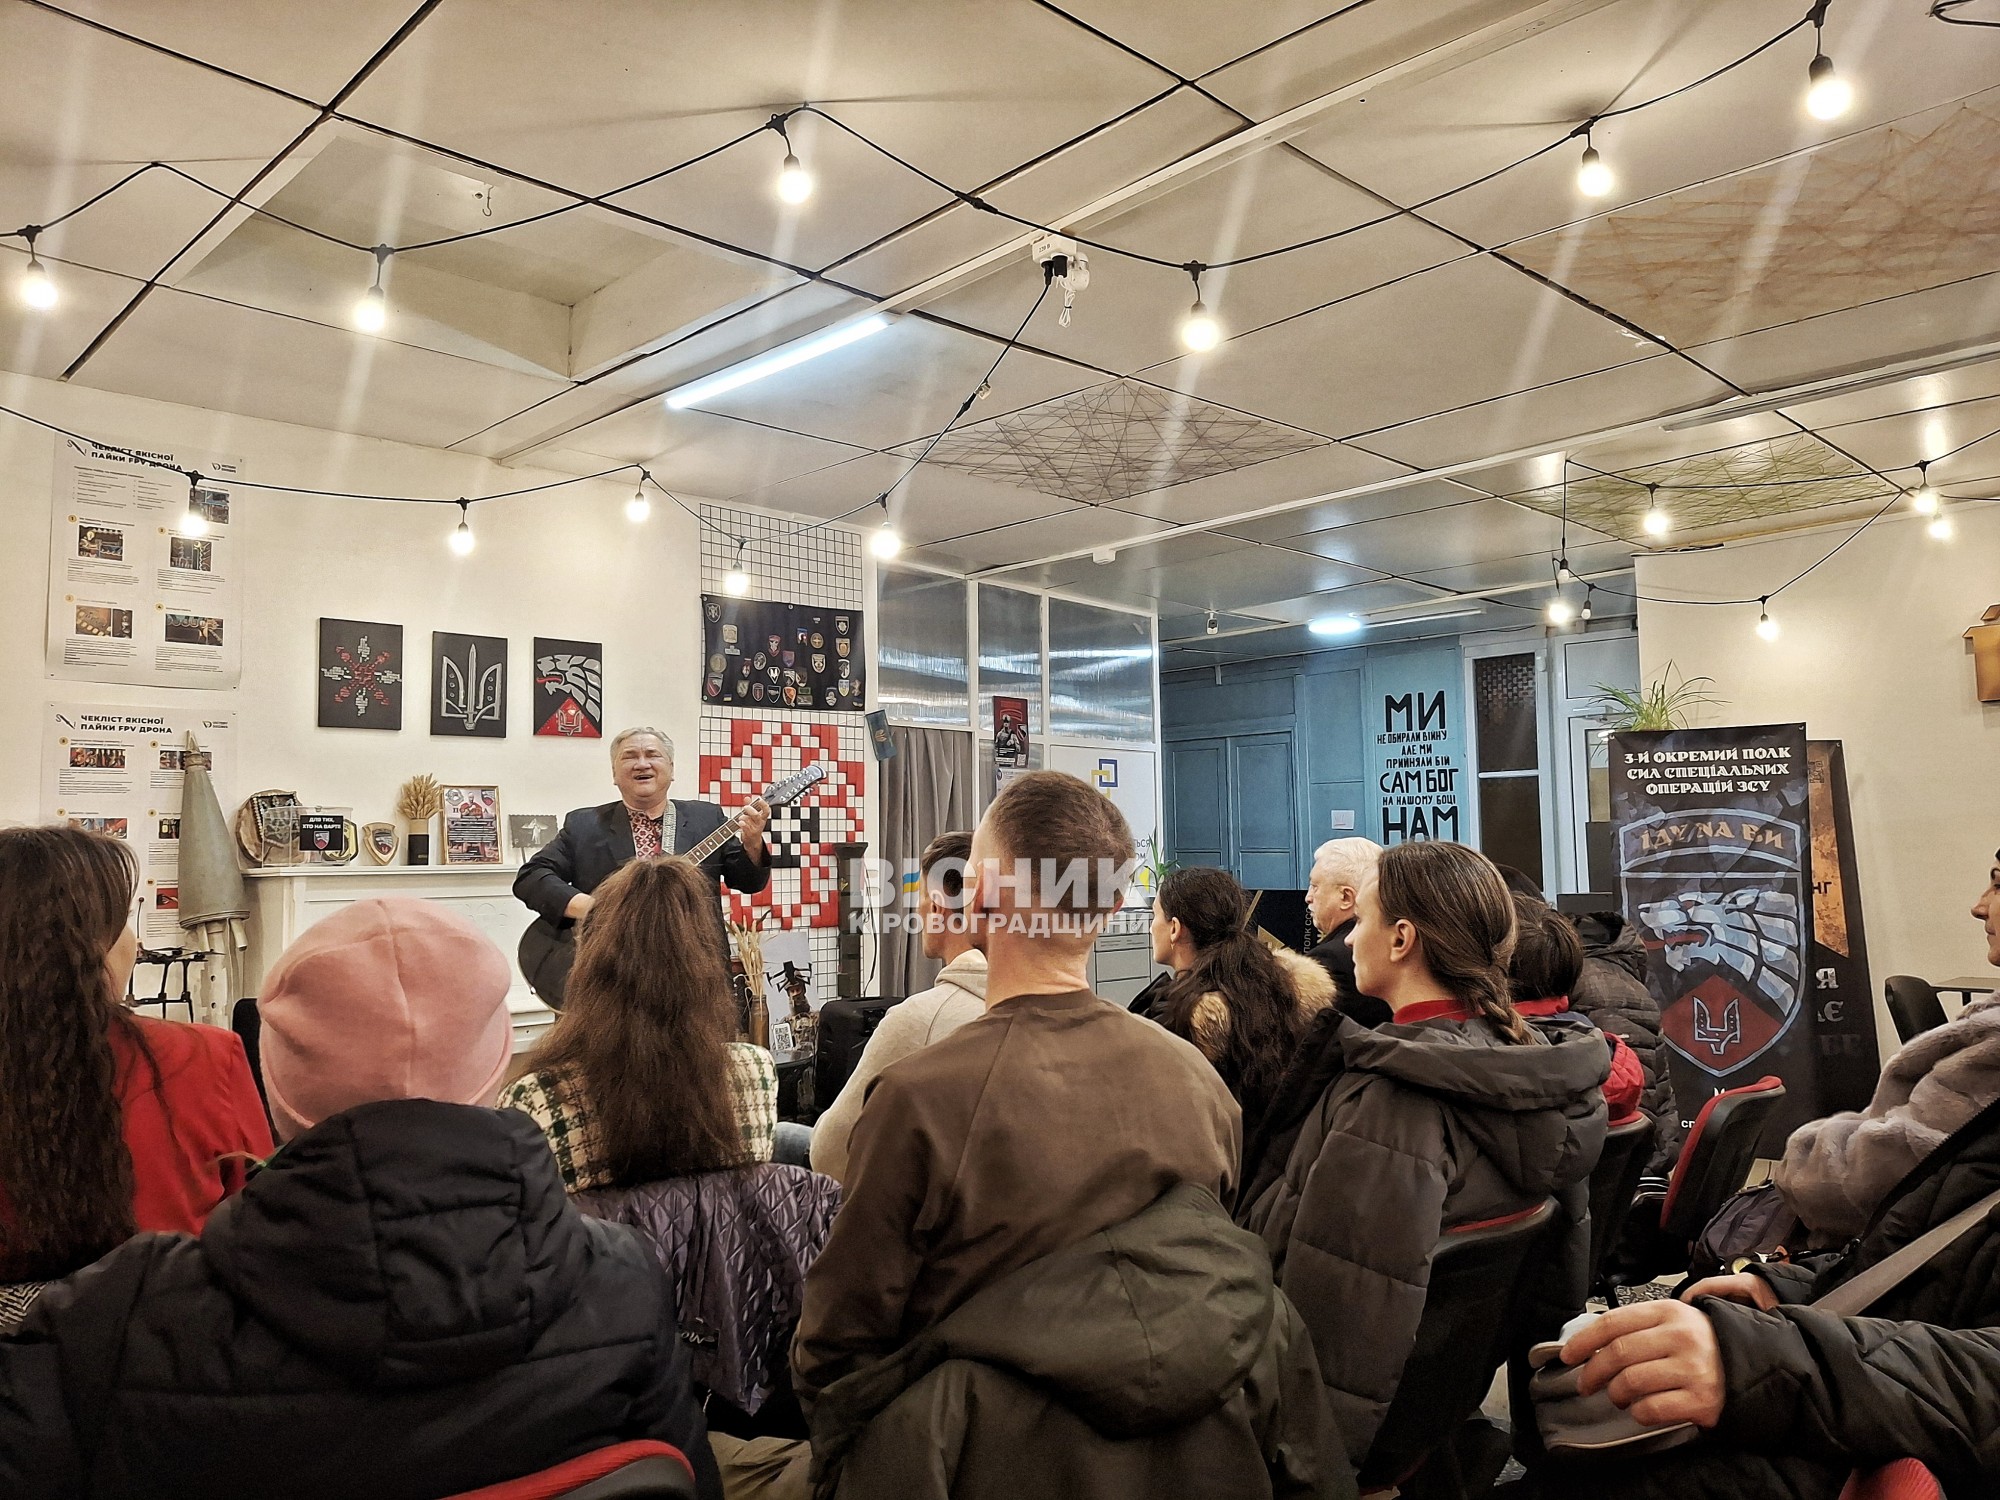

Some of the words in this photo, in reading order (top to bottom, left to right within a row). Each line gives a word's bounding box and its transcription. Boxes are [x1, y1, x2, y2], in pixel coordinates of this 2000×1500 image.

[91, 451, 125, 462] ПАЙКИ
[135, 450, 174, 461] ЯКІСНОЇ
[1385, 691, 1446, 733] МИ
[81, 715, 123, 723] ЧЕКЛІСТ
[125, 716, 164, 725] ЯКІСНОЇ
[81, 723, 115, 731] ПАЙКИ
[139, 726, 172, 734] ДРОНА
[1377, 734, 1387, 744] НЕ
[1387, 731, 1421, 744] ОБИРАЛИ
[1422, 729, 1447, 742] ВІЙНУ
[1401, 745, 1417, 756] АЛЕ
[1419, 743, 1433, 754] МИ
[1653, 747, 1738, 763] ОКРЕМИЙ
[1742, 747, 1792, 760] ПОЛК
[1386, 756, 1433, 769] ПРИЙНЯЛИ
[1435, 754, 1450, 767] БІЙ
[1626, 768, 1662, 780] СИЛ
[1664, 764, 1790, 779] СПЕЦІАЛЬНИХ
[1379, 770, 1422, 794] САМ
[1425, 768, 1459, 793] БОГ
[1645, 780, 1734, 795] ОПЕРАЦІЙ
[1737, 780, 1771, 792] ЗСУ
[1382, 796, 1394, 806] НА
[1396, 795, 1433, 806] НАШОМУ
[1436, 794, 1456, 805] БОЦІ
[1382, 806, 1459, 846] НАМ
[1741, 823, 1784, 849] ВИ
